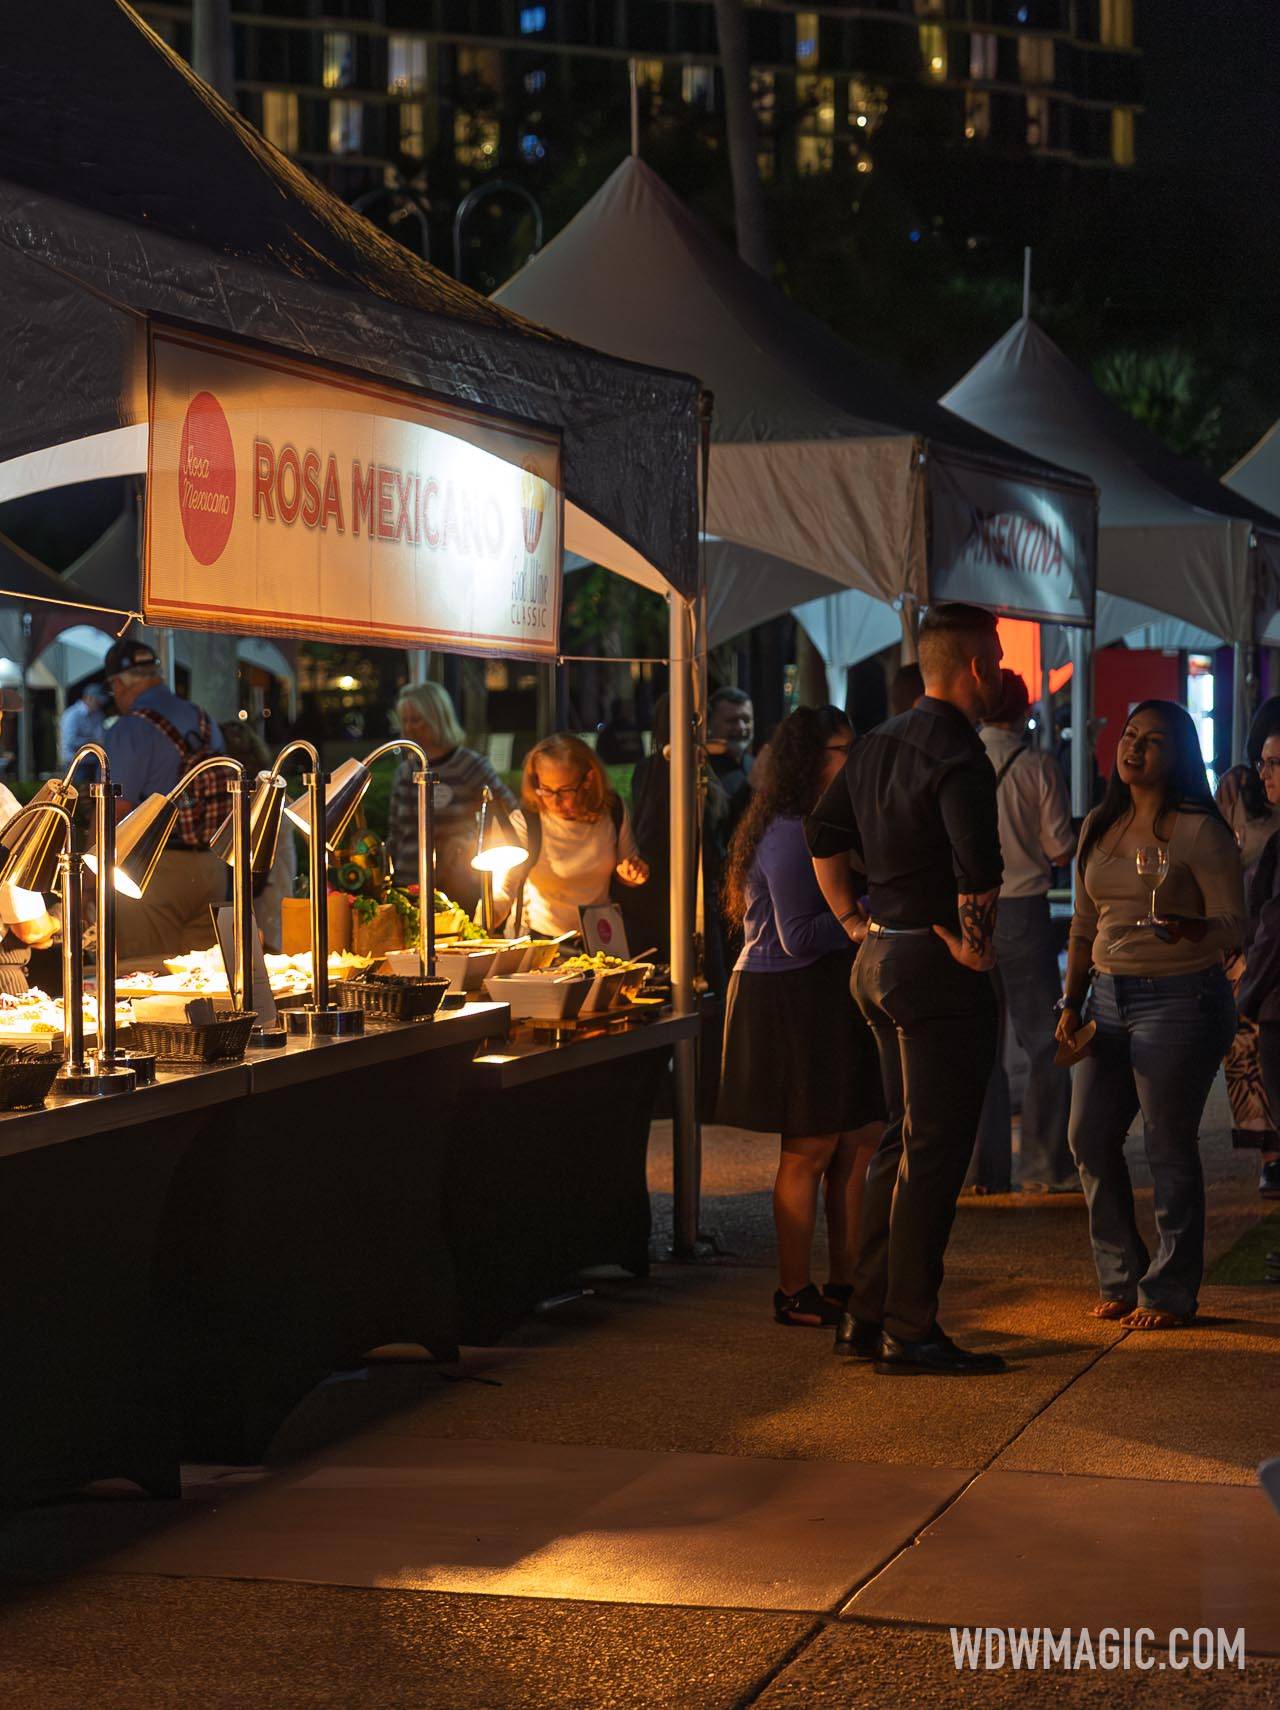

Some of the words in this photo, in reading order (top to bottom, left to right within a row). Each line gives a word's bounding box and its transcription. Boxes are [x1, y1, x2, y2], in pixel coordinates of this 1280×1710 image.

[183, 445, 209, 478] Rosa
[182, 479, 231, 514] Mexicano
[253, 440, 346, 534] ROSA
[352, 460, 505, 559] MEXICANO
[510, 604, 547, 628] CLASSIC
